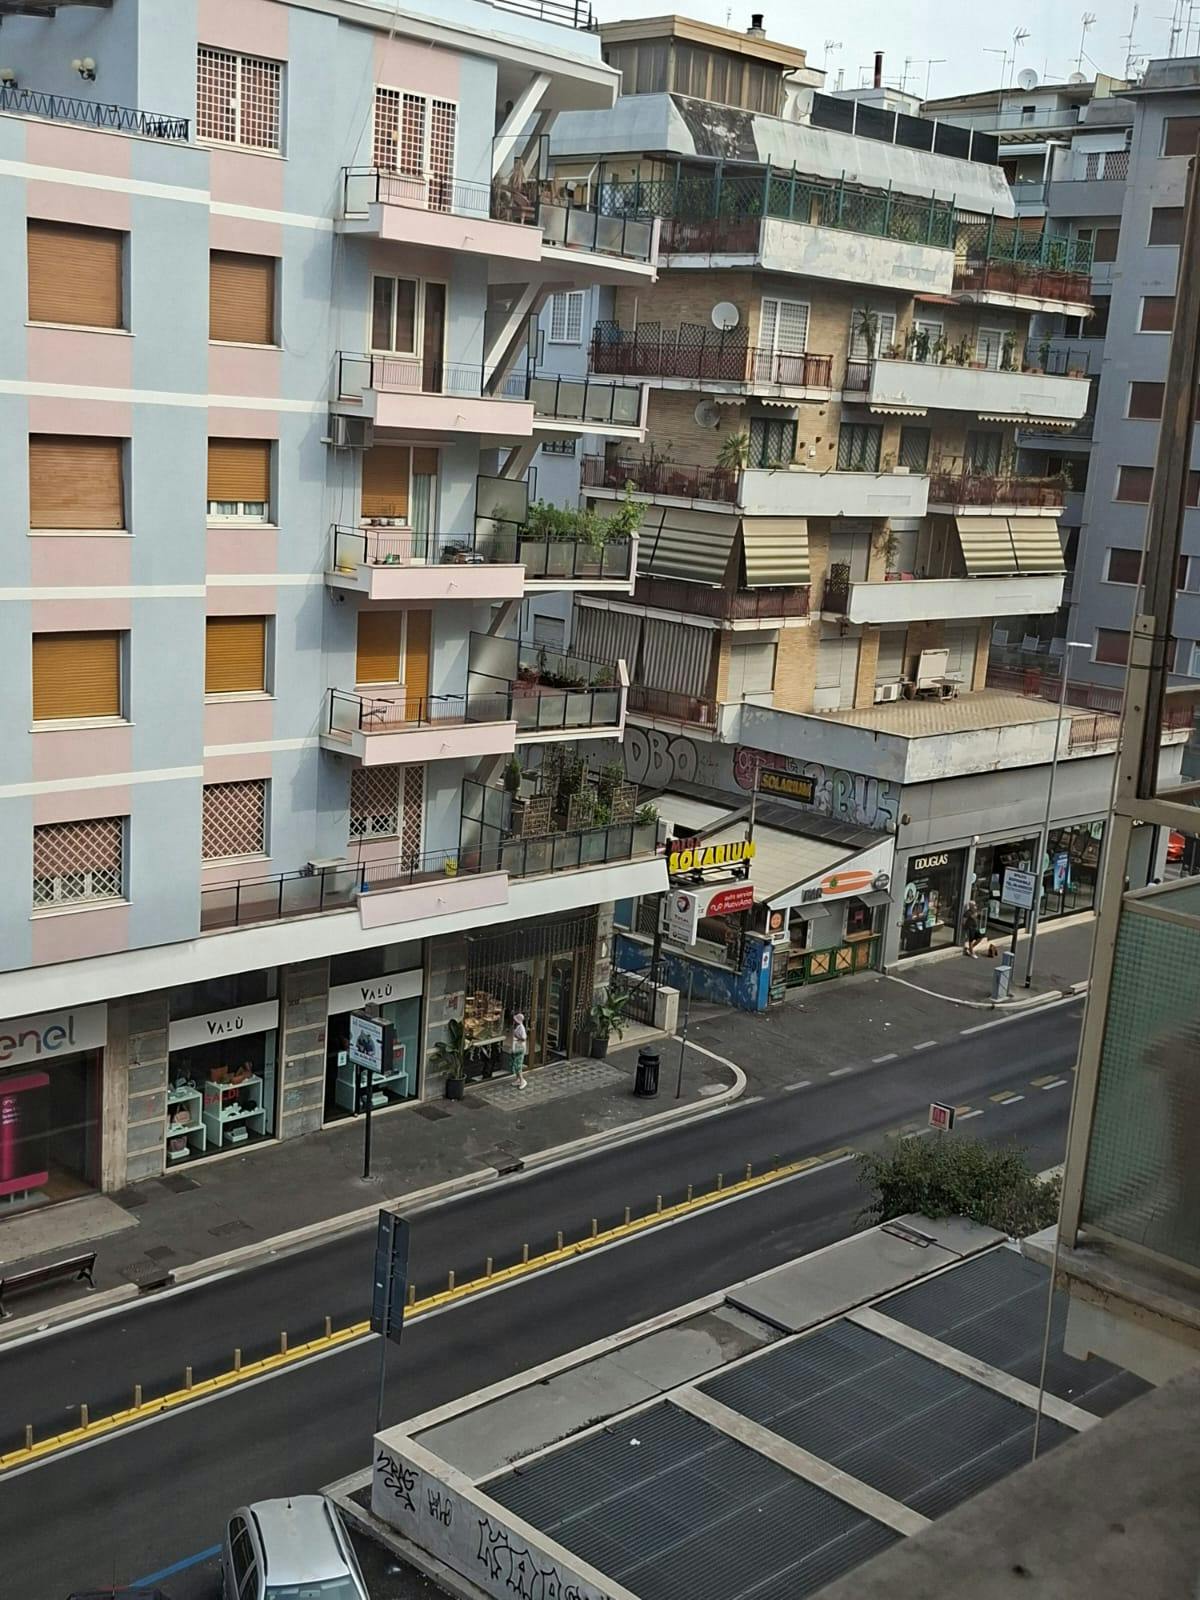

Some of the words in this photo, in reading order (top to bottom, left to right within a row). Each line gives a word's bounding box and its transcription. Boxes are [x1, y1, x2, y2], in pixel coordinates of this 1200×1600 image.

[624, 727, 698, 790] DBO
[761, 774, 813, 797] SOLARIUM
[669, 840, 756, 874] SOLARIUM
[914, 854, 949, 870] DOUGLAS
[0, 1015, 76, 1061] enel
